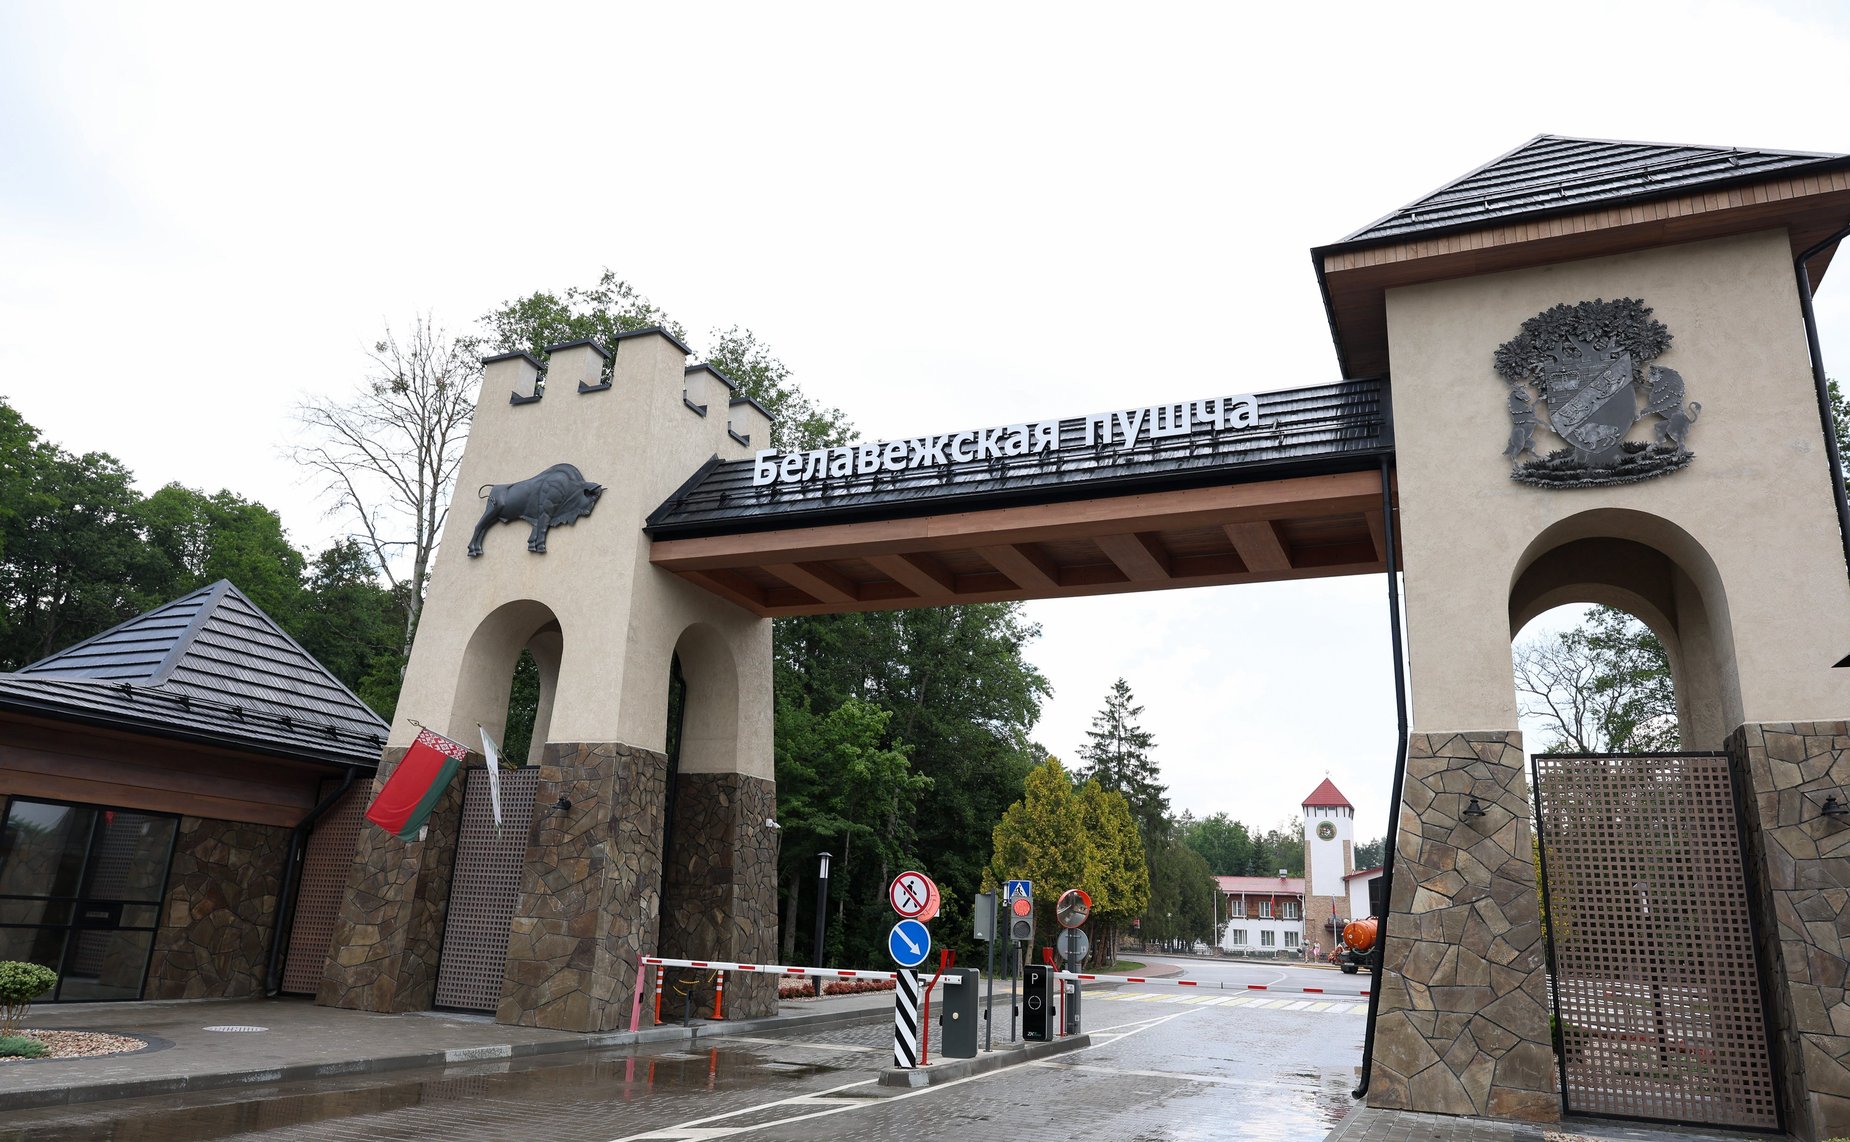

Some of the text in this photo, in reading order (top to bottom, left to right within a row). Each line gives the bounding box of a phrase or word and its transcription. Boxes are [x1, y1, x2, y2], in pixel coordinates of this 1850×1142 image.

[752, 393, 1259, 486] Белавежская пушча
[1031, 973, 1039, 985] P
